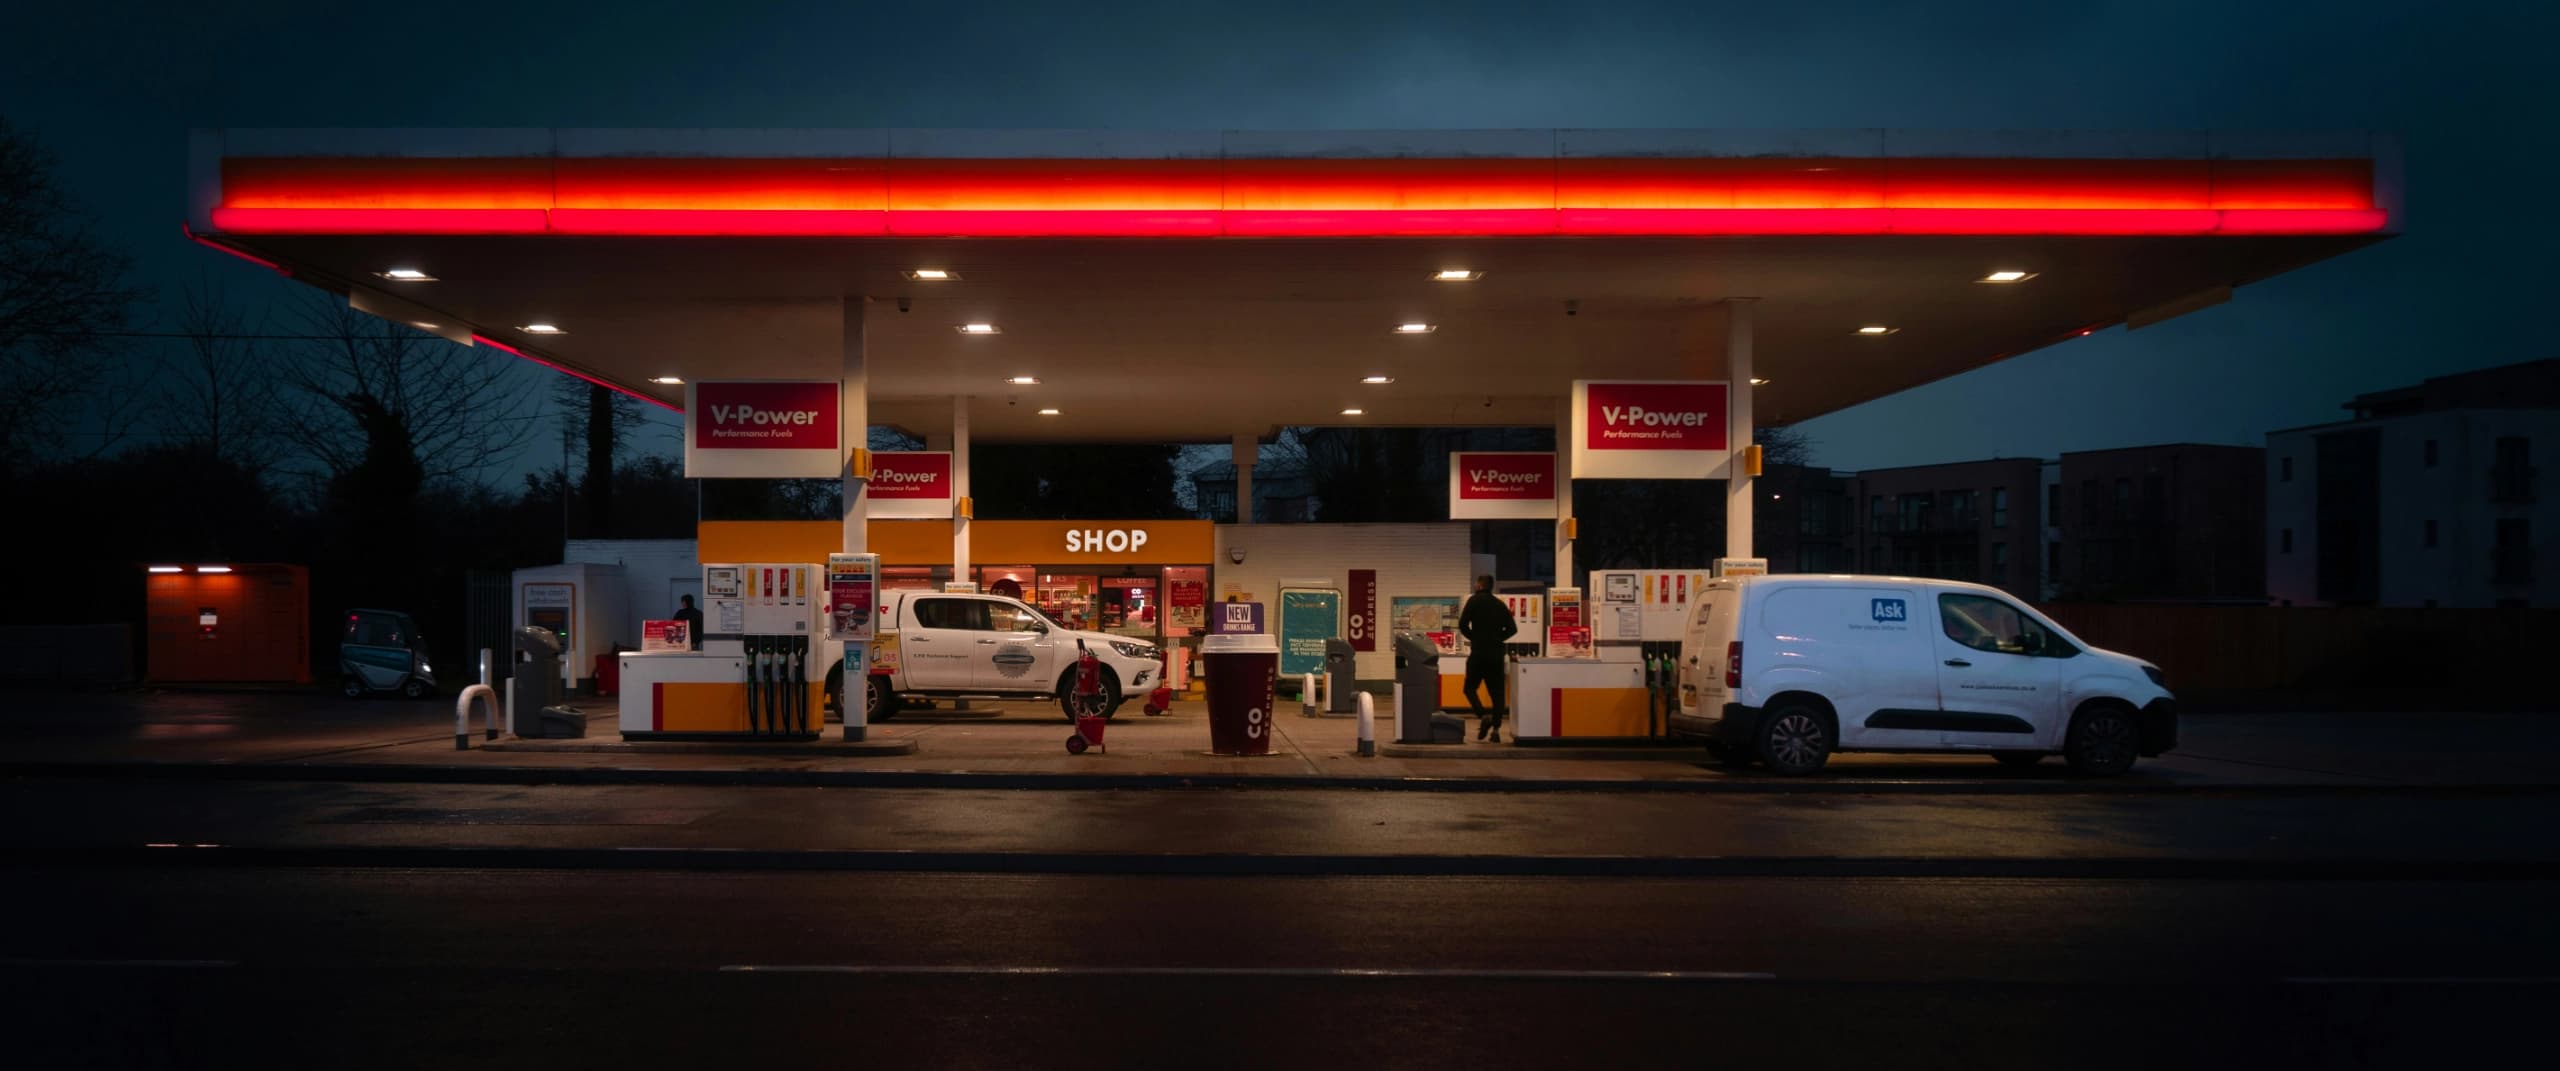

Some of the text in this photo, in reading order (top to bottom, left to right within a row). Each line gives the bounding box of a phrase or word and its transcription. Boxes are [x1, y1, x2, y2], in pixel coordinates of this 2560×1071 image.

[711, 404, 819, 425] V-Power
[1602, 405, 1709, 427] V-Power
[712, 428, 793, 438] Performance Fuels
[1603, 429, 1683, 439] Performance Fuels
[1470, 469, 1543, 484] V-Power
[1066, 528, 1148, 553] SHOP
[1228, 607, 1249, 621] NEW
[1367, 581, 1375, 630] EXPRESS
[1875, 601, 1903, 618] Ask
[1223, 623, 1256, 631] DRINKS RANGE
[1349, 614, 1364, 640] CO
[884, 653, 896, 662] 05
[1247, 706, 1263, 739] CO
